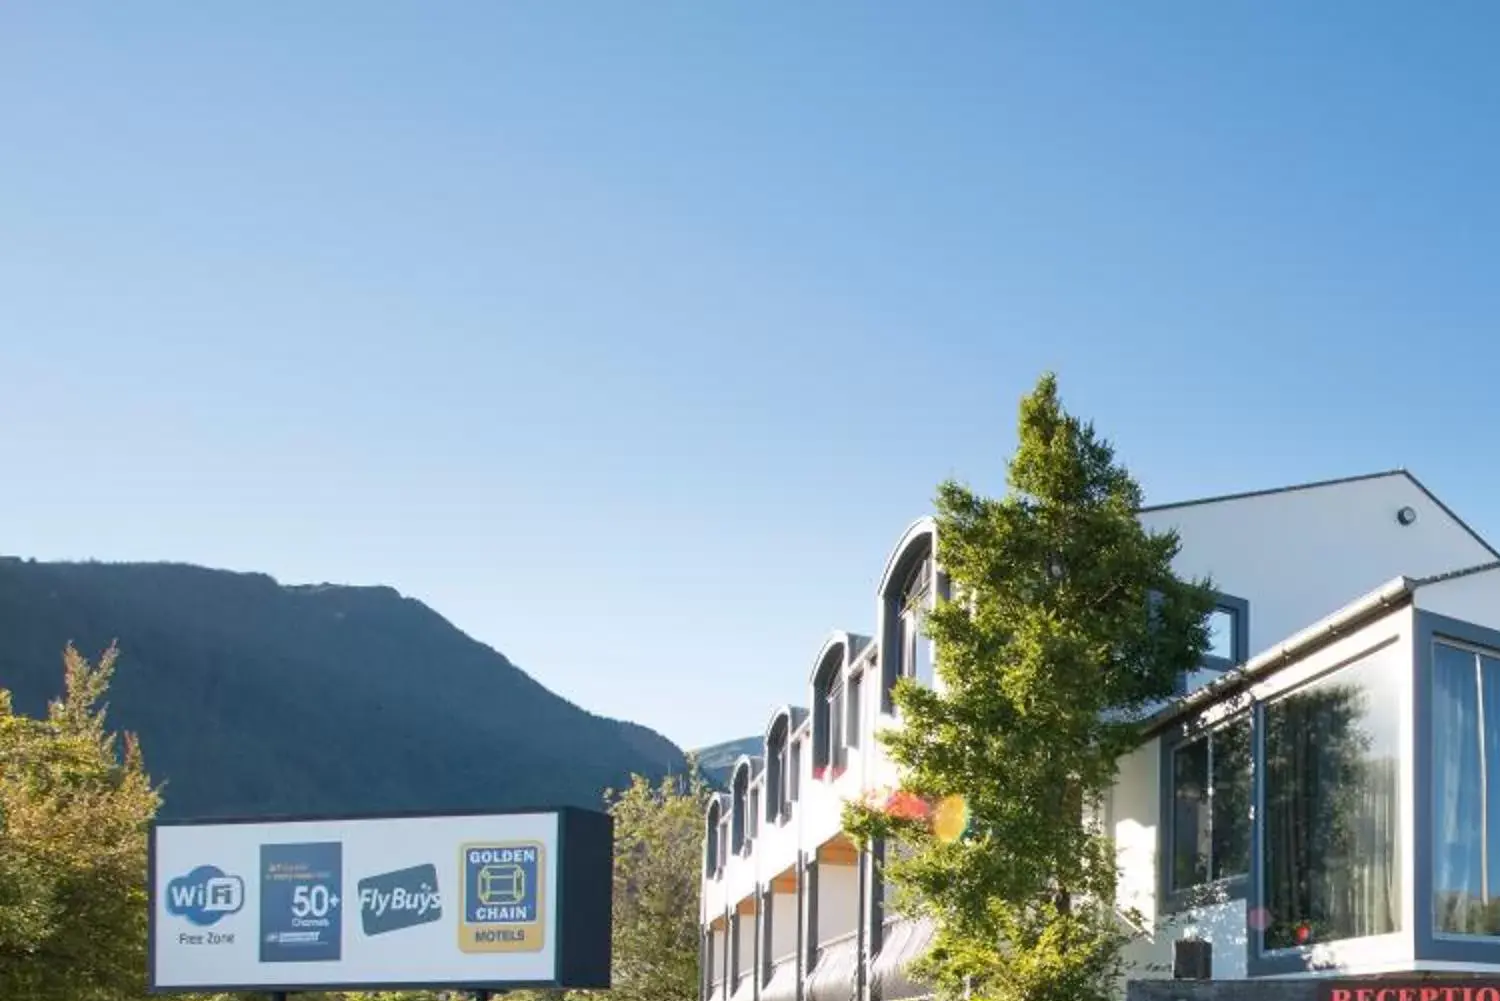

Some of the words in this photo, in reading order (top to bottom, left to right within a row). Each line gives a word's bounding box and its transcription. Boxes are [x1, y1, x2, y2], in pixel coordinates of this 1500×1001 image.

[469, 849, 535, 864] GOLDEN
[291, 885, 341, 917] 50+
[475, 906, 527, 921] CHAIN
[179, 932, 203, 945] Free
[207, 931, 236, 945] Zone
[475, 929, 526, 943] MOTELS
